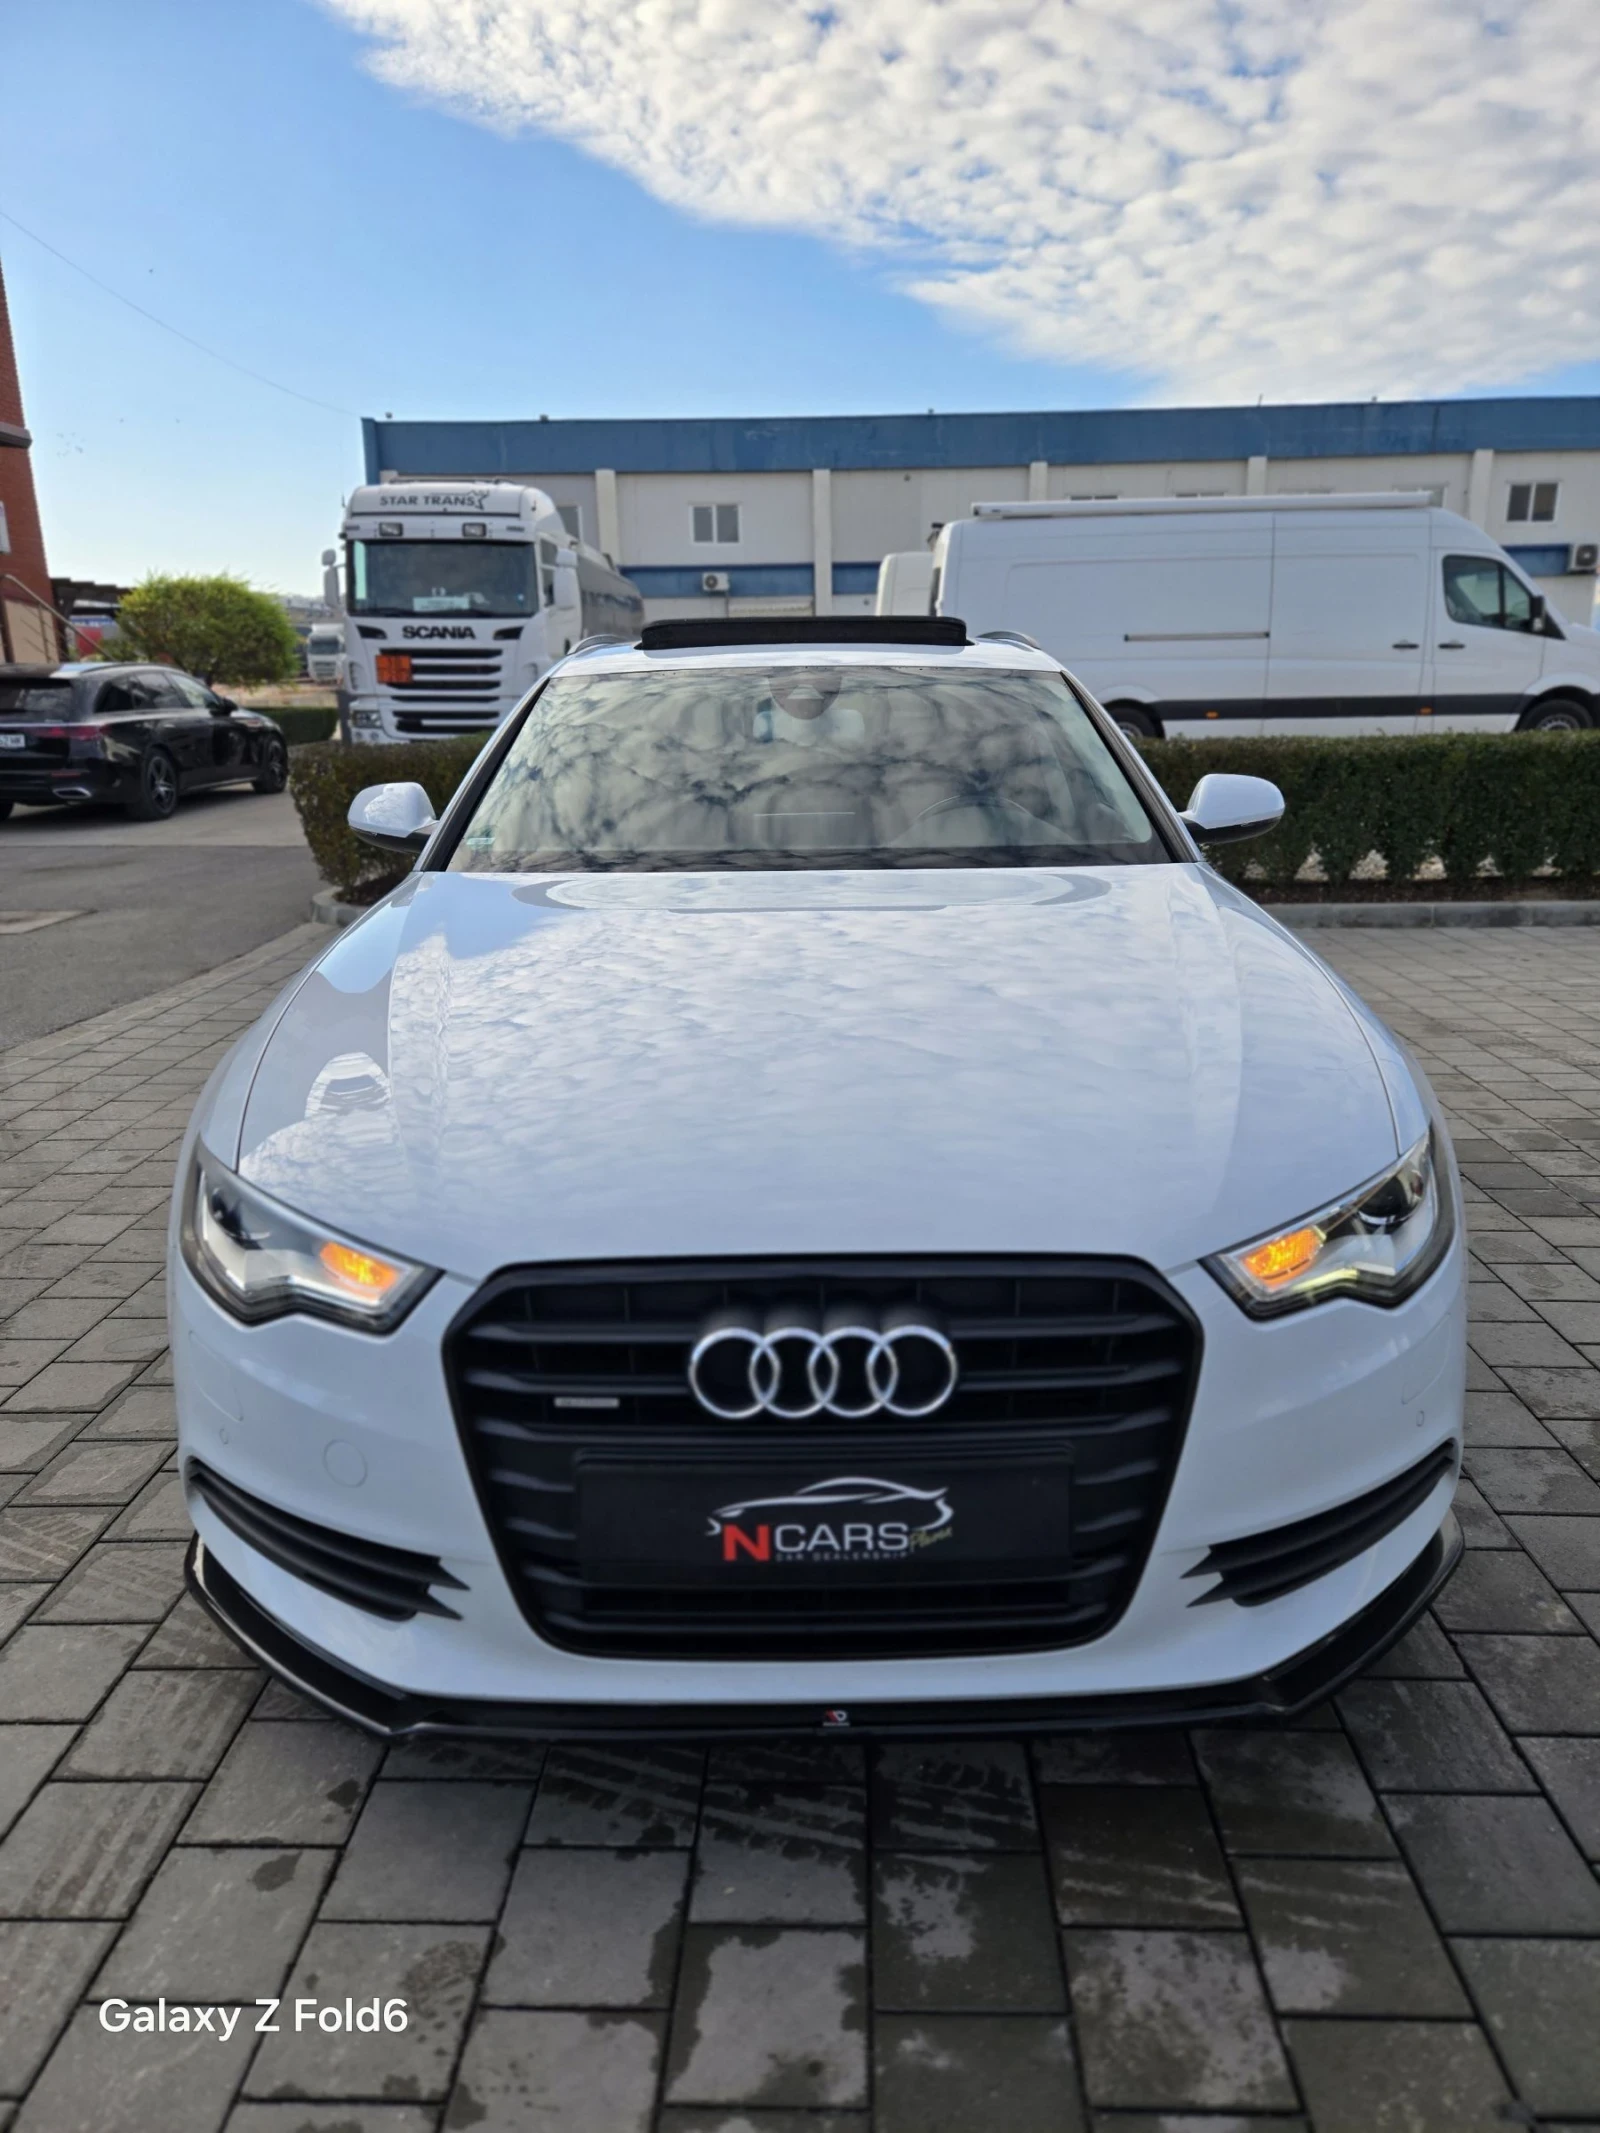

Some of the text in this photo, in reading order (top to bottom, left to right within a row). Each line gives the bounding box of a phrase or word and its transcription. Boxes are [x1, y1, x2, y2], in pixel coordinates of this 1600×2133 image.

[380, 496, 475, 506] STAR TRANS
[402, 625, 476, 639] SCANIA
